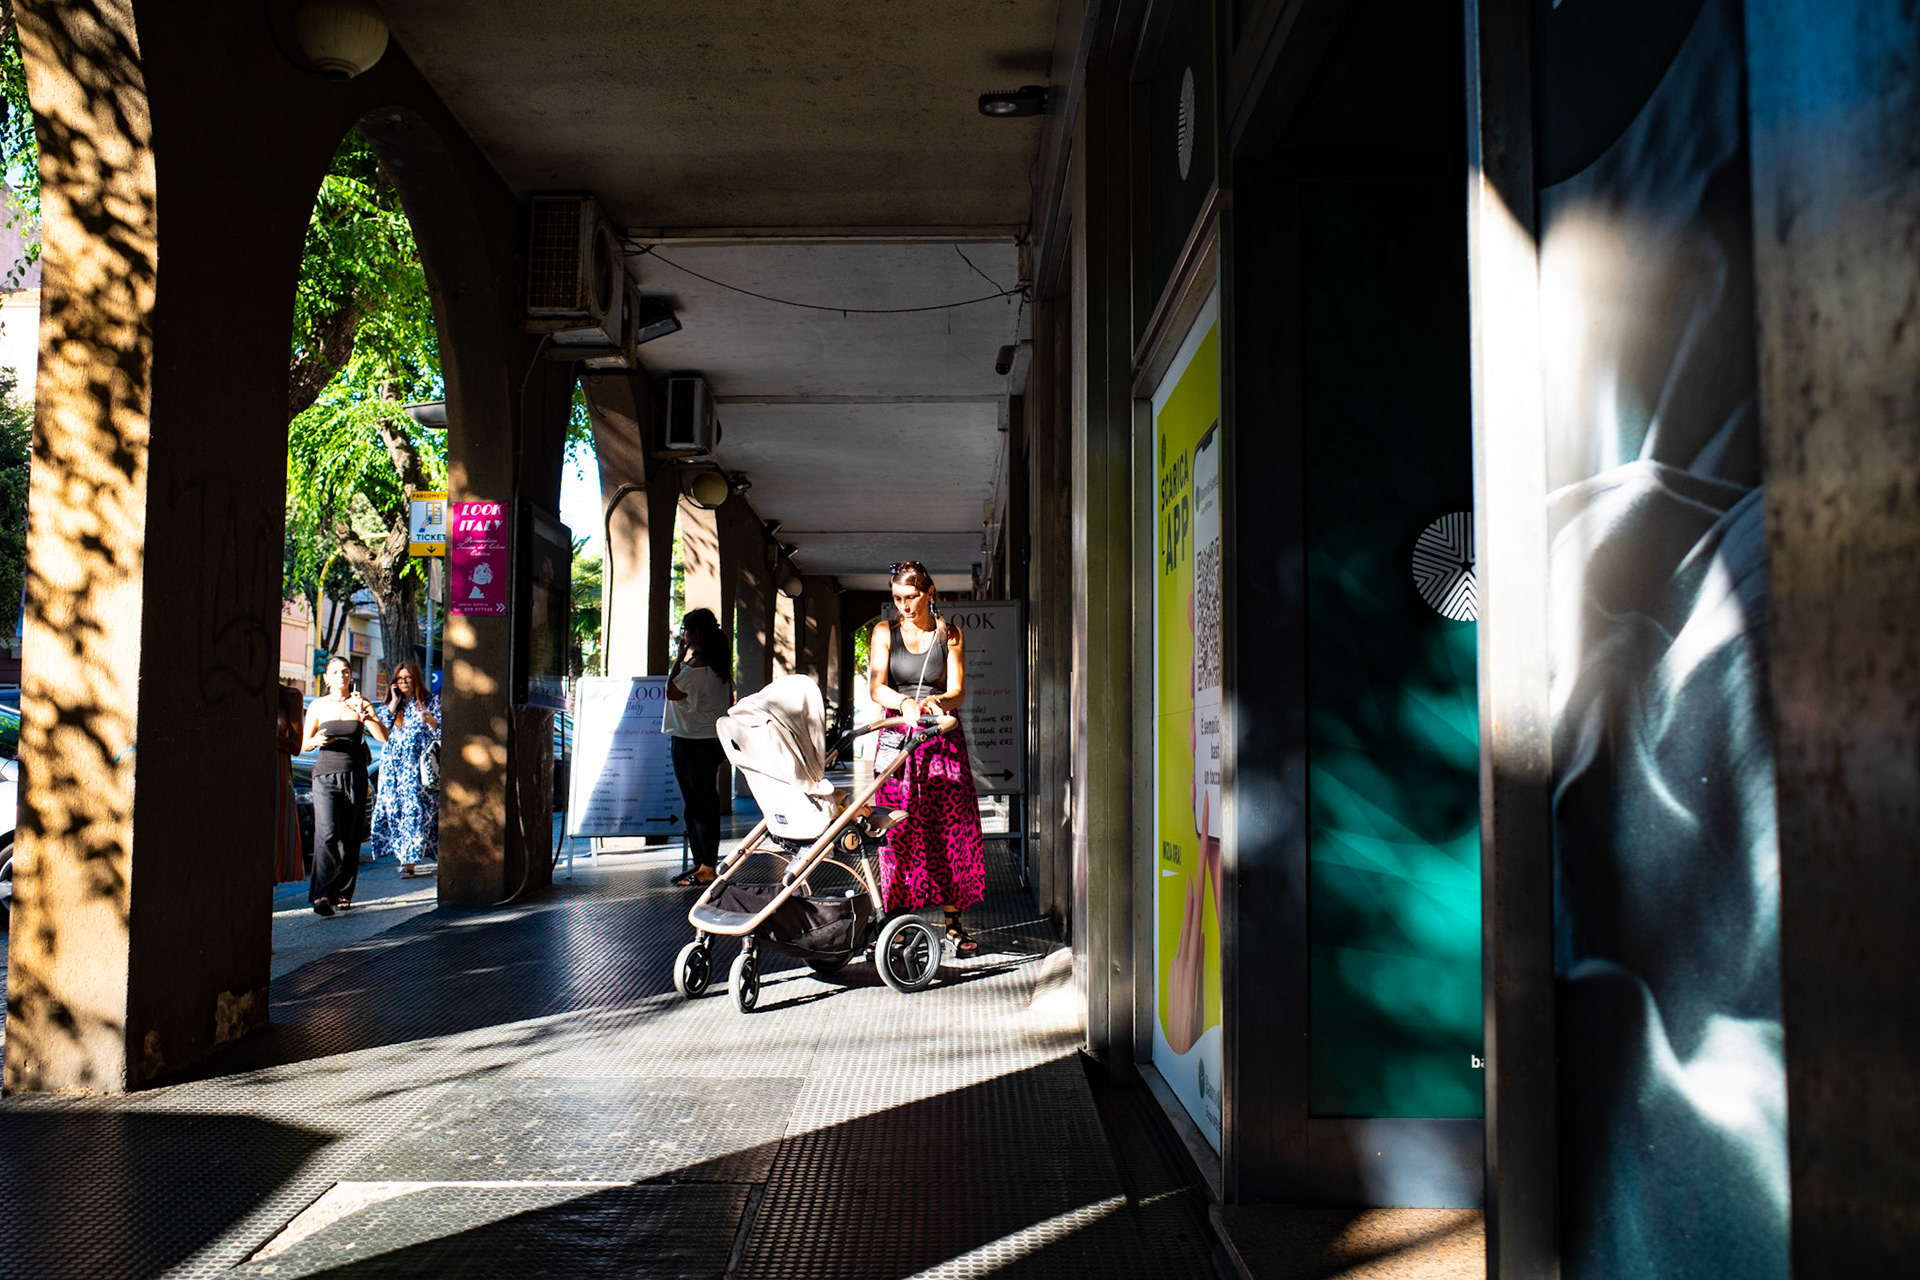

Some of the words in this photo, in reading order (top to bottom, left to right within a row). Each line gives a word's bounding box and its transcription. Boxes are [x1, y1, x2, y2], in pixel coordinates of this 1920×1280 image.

[1161, 448, 1189, 512] SCARICA
[461, 504, 502, 516] LOOK
[458, 520, 503, 532] ITALY
[950, 613, 997, 630] OOK
